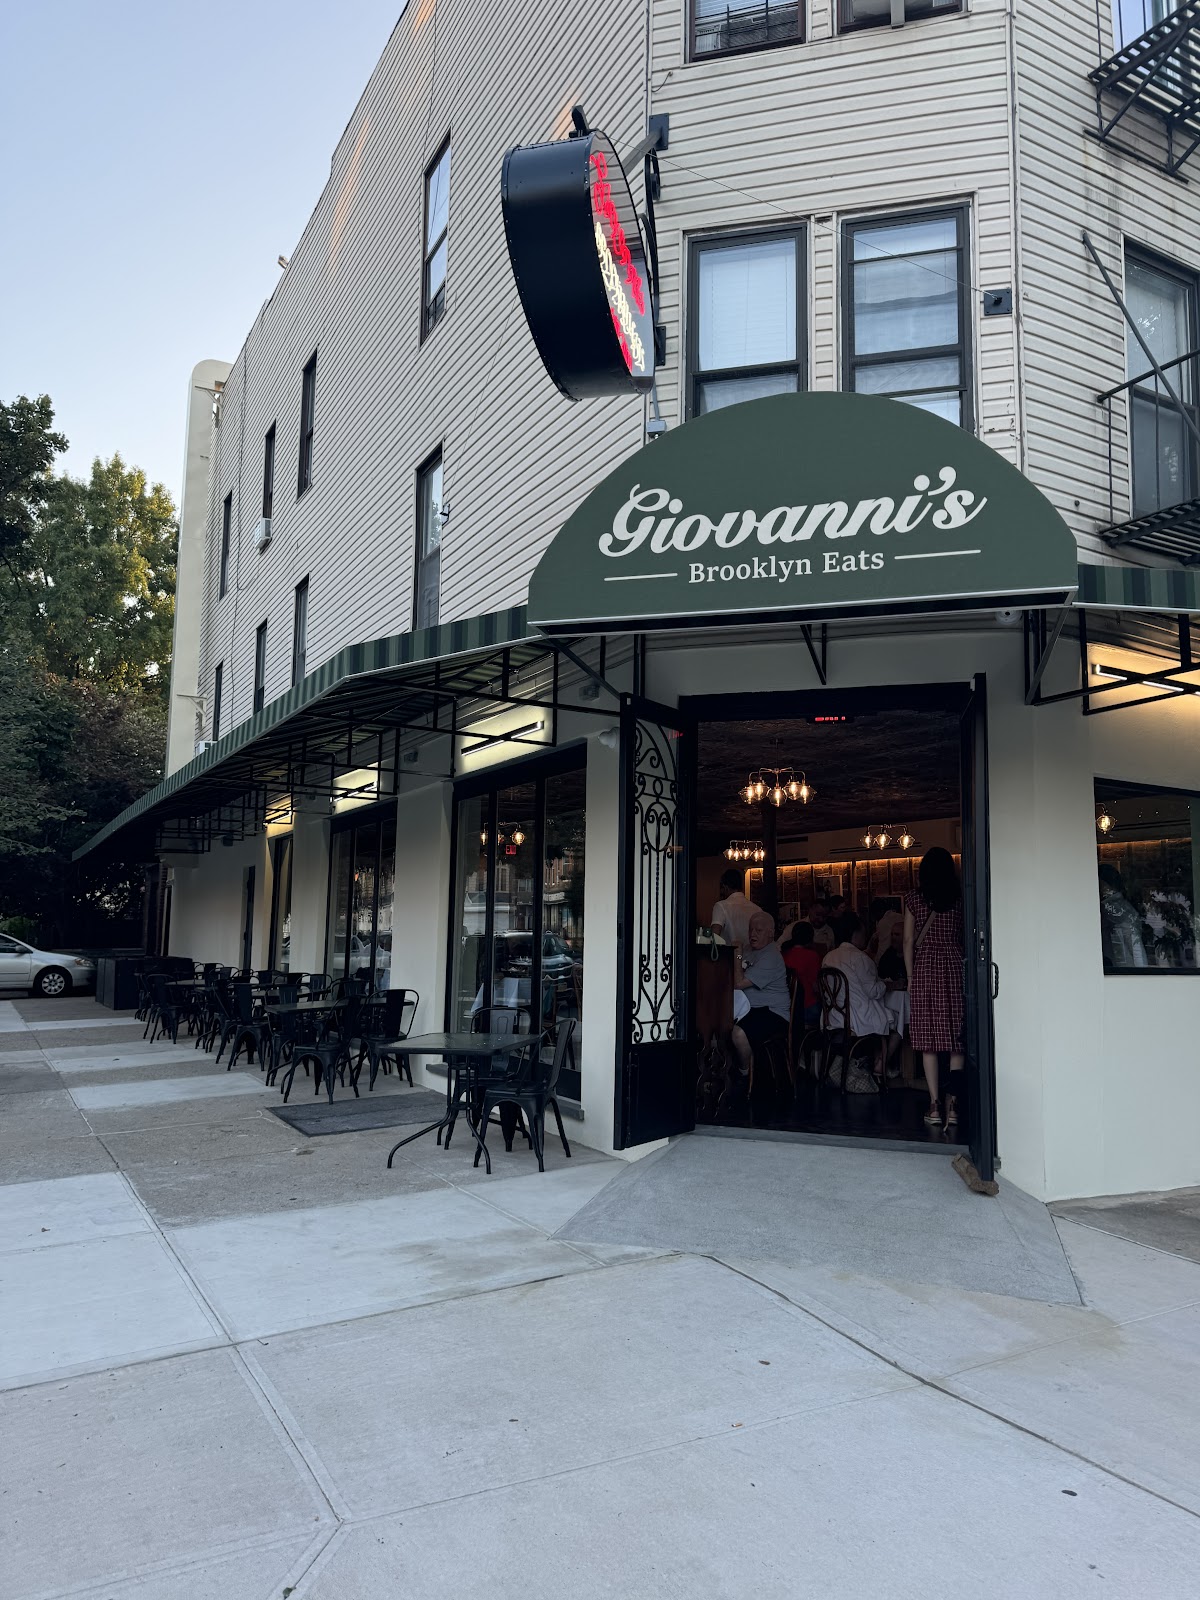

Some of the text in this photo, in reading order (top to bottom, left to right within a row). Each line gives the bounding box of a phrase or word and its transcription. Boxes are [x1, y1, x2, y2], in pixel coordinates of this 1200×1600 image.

[598, 466, 988, 558] Giovanni's
[688, 550, 885, 583] Brooklyn Eats
